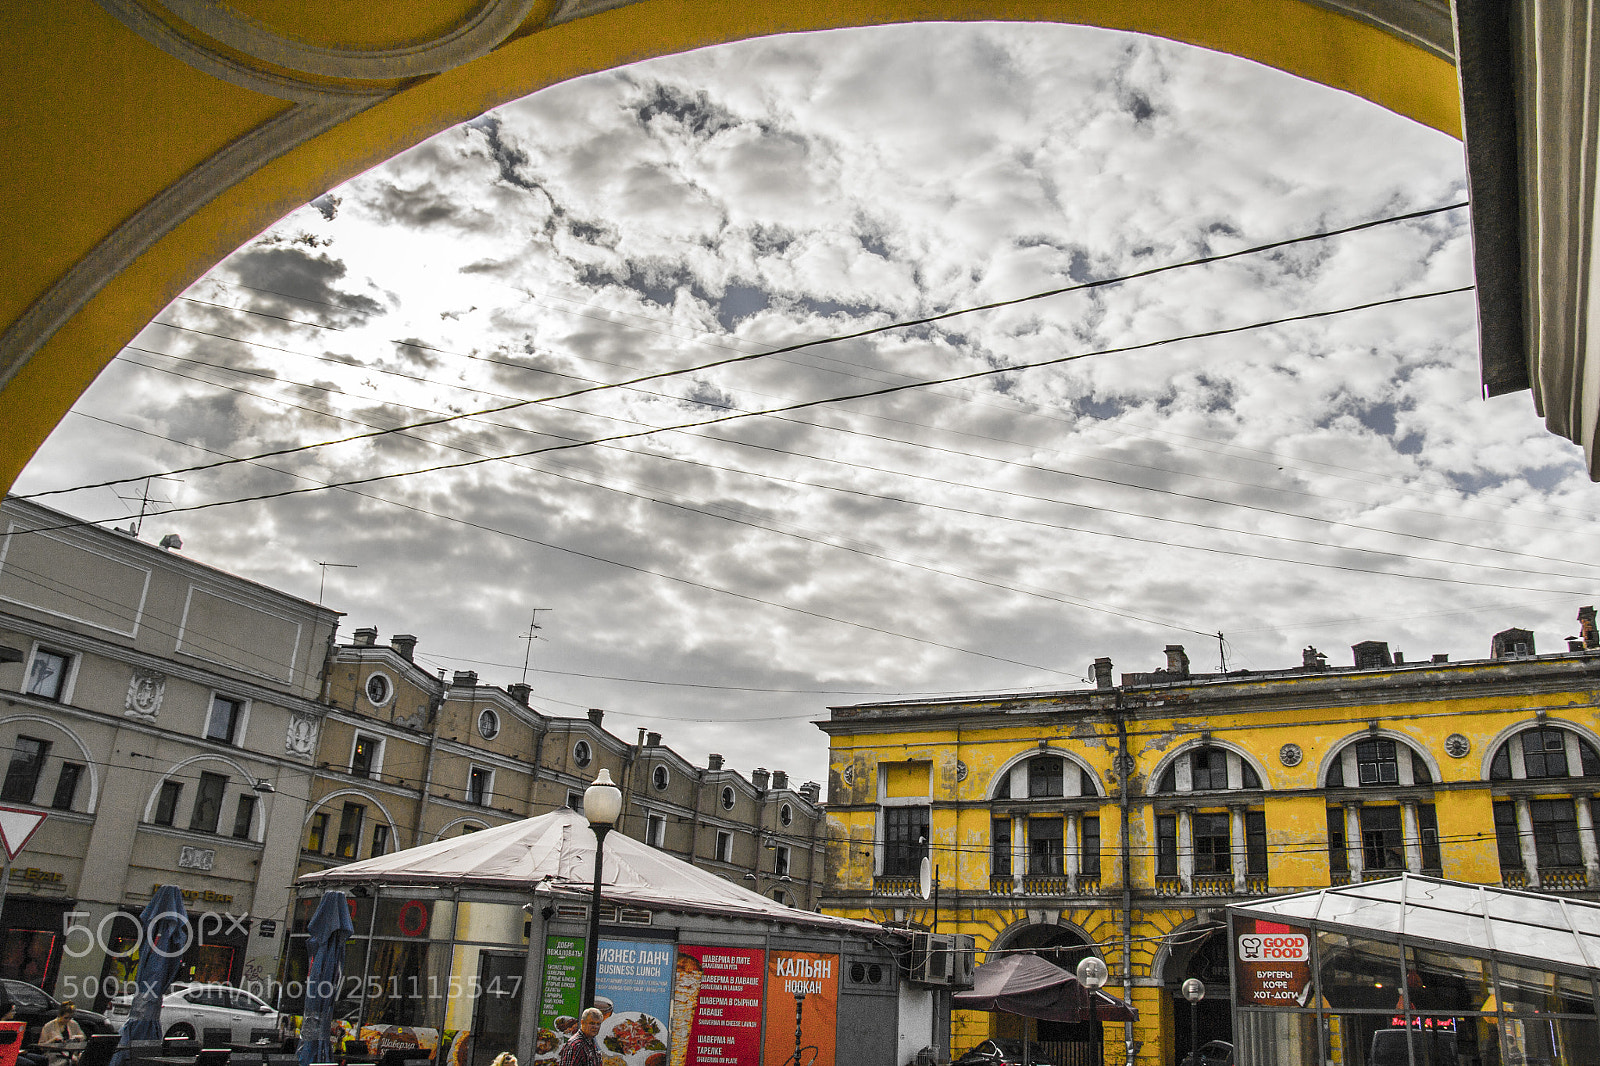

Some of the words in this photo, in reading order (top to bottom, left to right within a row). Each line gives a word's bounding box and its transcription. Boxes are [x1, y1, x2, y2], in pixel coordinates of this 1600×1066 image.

[557, 941, 574, 949] ДОБРО
[1263, 938, 1304, 948] GOOD
[1263, 948, 1303, 958] FOOD
[638, 951, 669, 966] ЛАНЧ
[702, 954, 730, 963] ШАВЕРМА
[731, 956, 735, 964] В
[736, 956, 751, 965] ПИТЕ
[599, 964, 635, 976] BUSINESS
[636, 966, 661, 977] LUNCH
[776, 957, 832, 979] КАЛЬЯН
[701, 974, 729, 983] ШАВЕРМА
[730, 976, 735, 984] В
[735, 976, 759, 985] ЛАВАШЕ
[1256, 970, 1293, 979] БУРГЕРЫ
[784, 980, 822, 994] HOOKAH
[1262, 981, 1288, 989] КОФЕ
[1253, 991, 1299, 999] ХОТ-ДОГИ
[699, 996, 728, 1005] ШАВЕРМА
[729, 998, 733, 1006] В
[734, 998, 759, 1007] СЫРНОМ
[698, 1007, 723, 1016] ЛАВАШЕ
[697, 1035, 726, 1044] ШАВЕРМА
[726, 1036, 735, 1045] НА
[697, 1046, 723, 1055] ТАРЕЛКЕ
